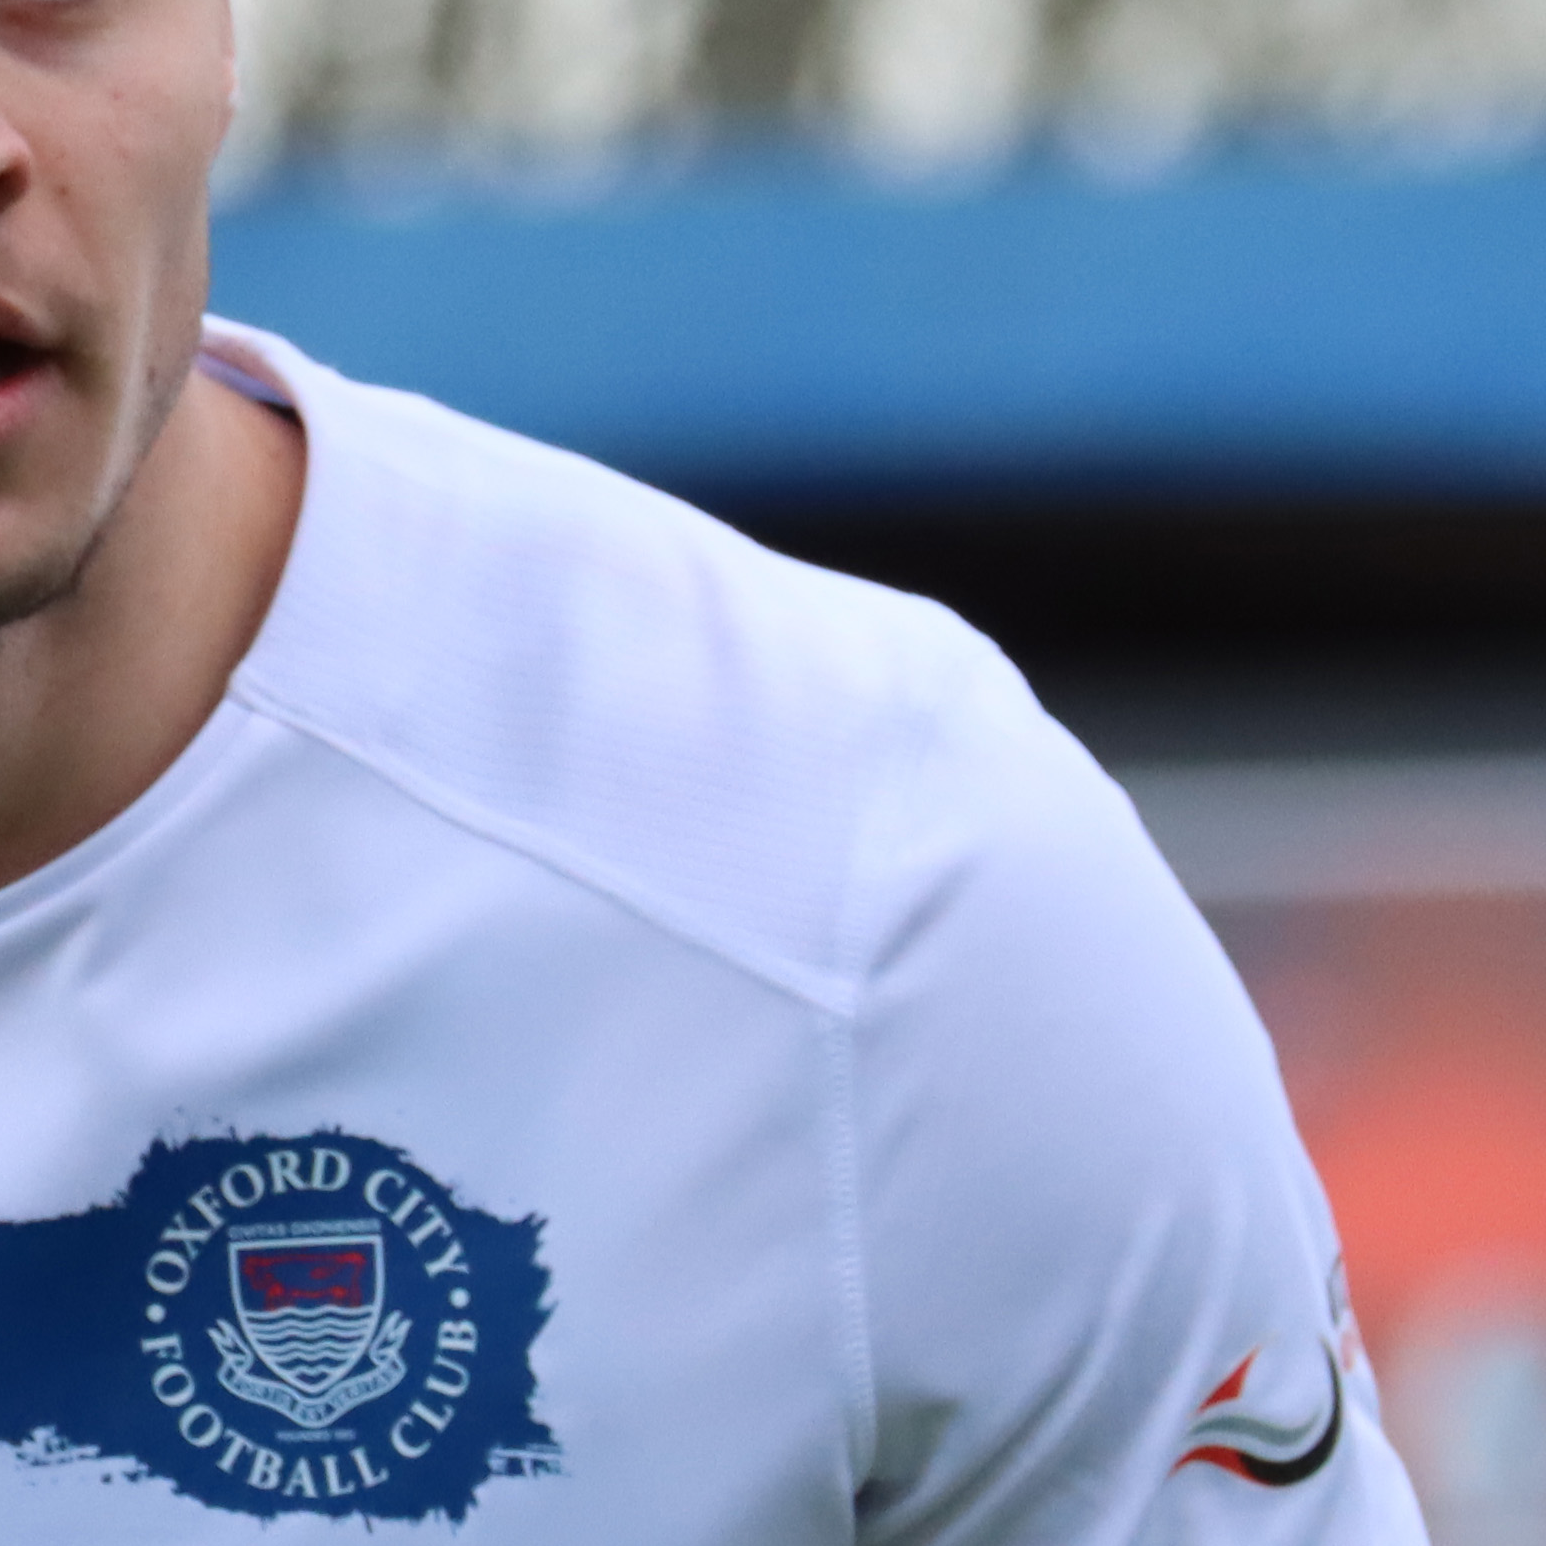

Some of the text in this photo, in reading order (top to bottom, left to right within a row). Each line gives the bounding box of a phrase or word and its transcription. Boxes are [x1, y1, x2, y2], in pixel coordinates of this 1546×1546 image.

[145, 1147, 470, 1295] OXFORD CITY
[141, 1333, 390, 1499] FOOTBALL
[390, 1319, 479, 1459] CLUB
